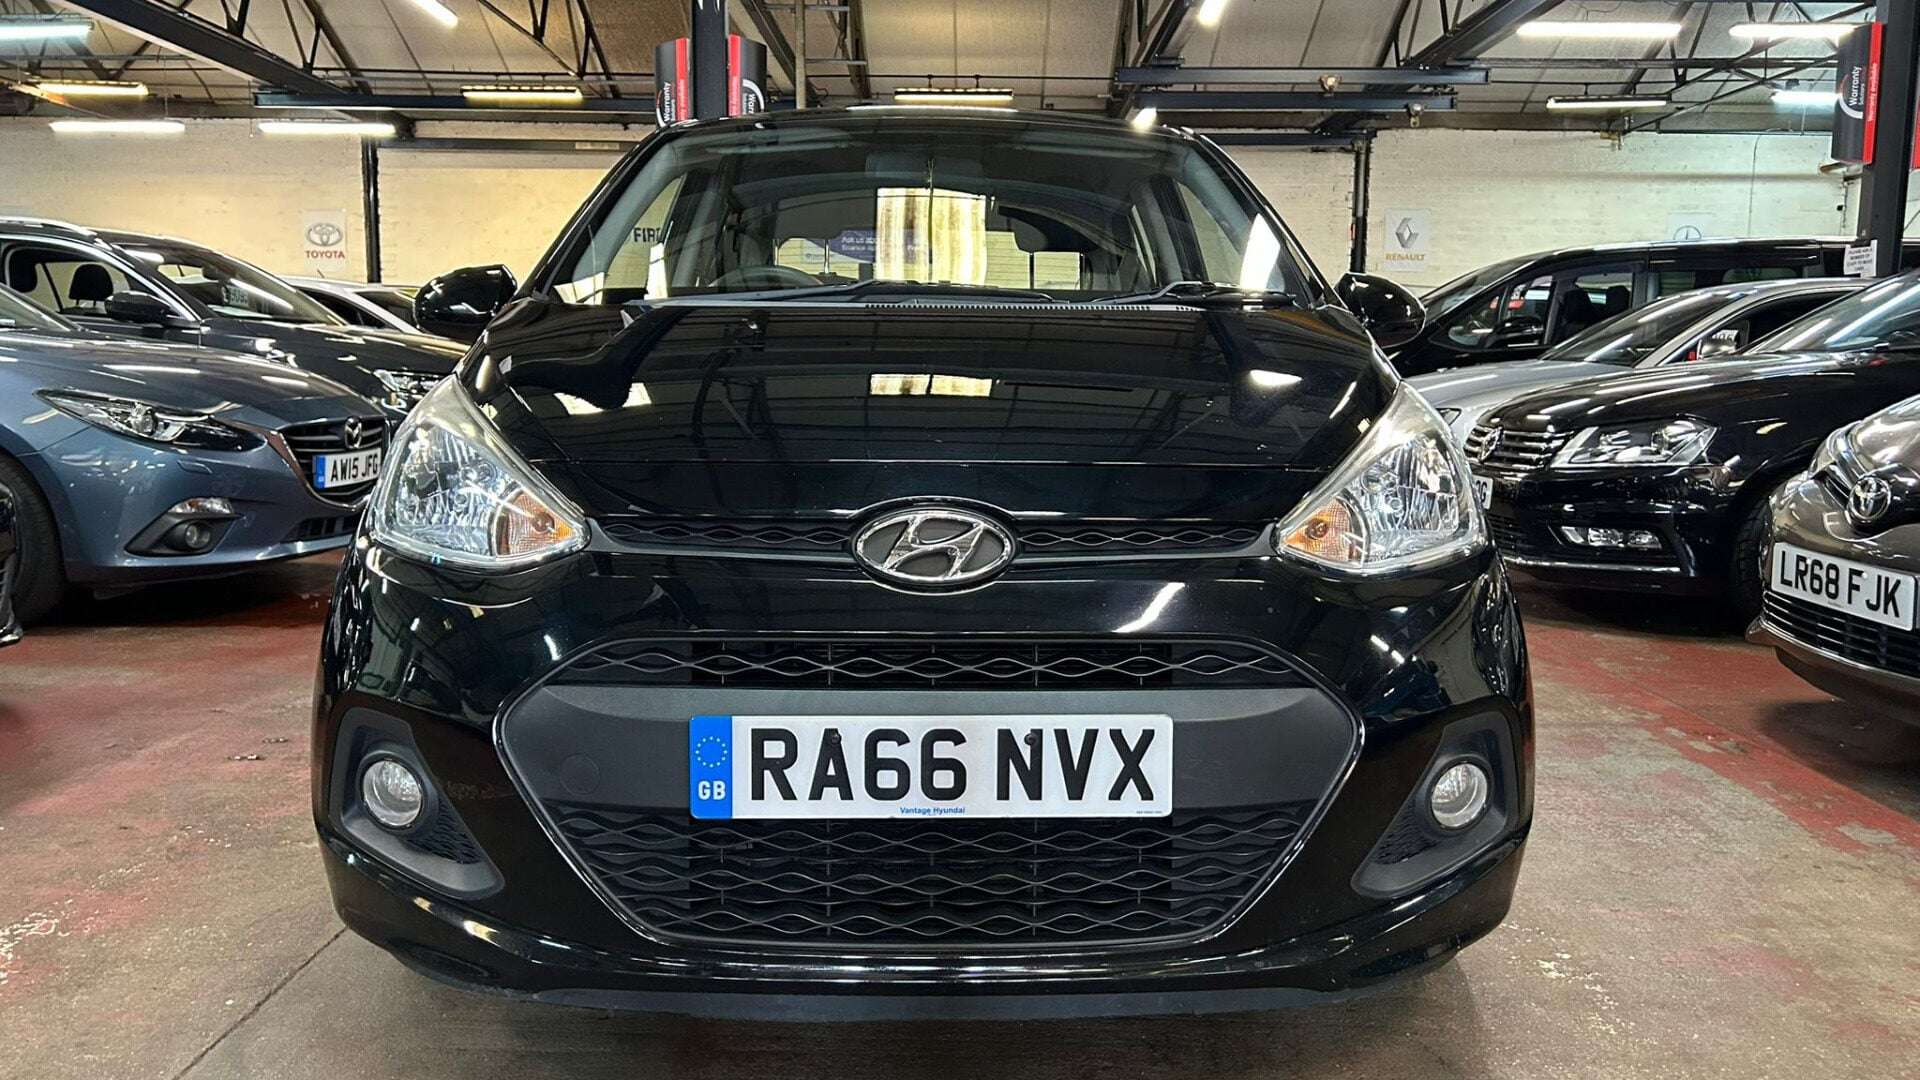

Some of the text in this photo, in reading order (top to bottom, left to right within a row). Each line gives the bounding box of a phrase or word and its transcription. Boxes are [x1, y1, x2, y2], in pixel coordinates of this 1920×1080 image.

[1848, 66, 1862, 106] Warranty
[663, 81, 671, 122] Warranty
[748, 93, 756, 114] Warr
[305, 250, 345, 259] TOYOTA
[331, 453, 378, 481] AW15 JFG
[1780, 551, 1840, 600] LR68
[751, 728, 1155, 801] RA66 NVX
[698, 780, 726, 800] GB
[900, 807, 966, 815] Vantage Hyundai
